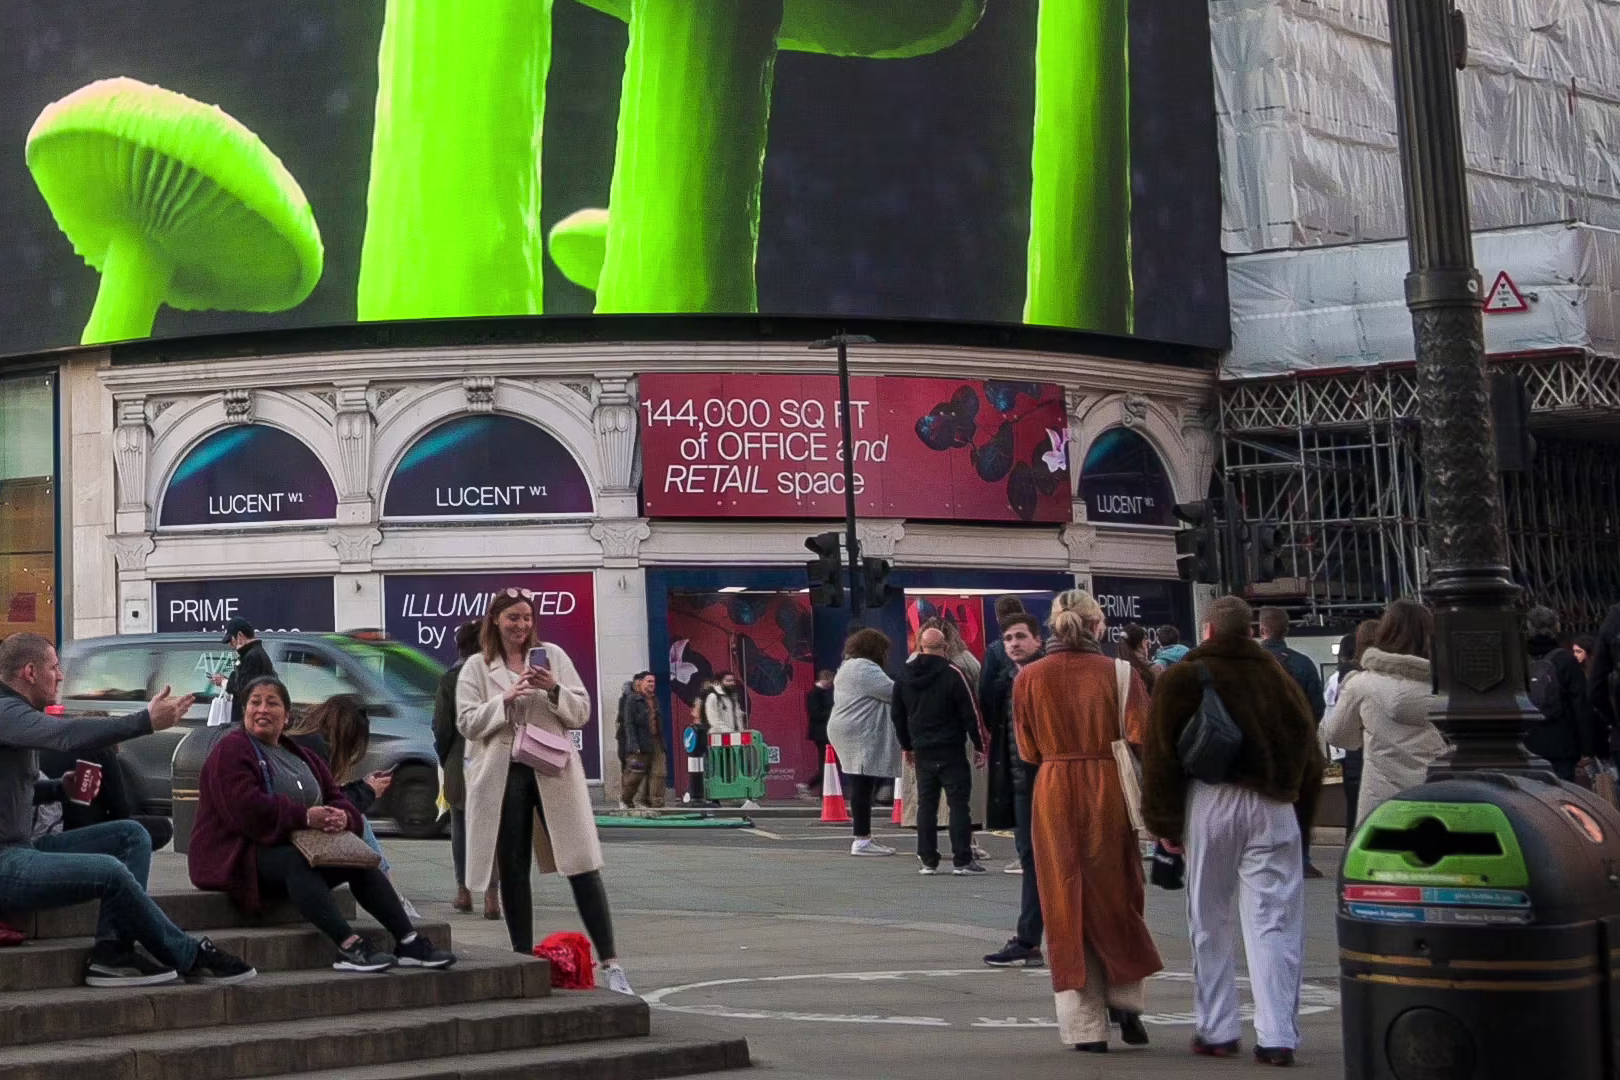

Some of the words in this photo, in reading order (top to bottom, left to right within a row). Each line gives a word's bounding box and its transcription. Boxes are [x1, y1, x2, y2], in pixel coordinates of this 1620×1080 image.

[641, 398, 772, 431] 144,000
[779, 399, 825, 428] SQ
[680, 432, 709, 461] of
[717, 431, 828, 461] OFFICE
[664, 464, 769, 494] RETAIL
[776, 470, 866, 500] space
[208, 493, 285, 515] LUCENT
[287, 492, 304, 503] W1
[435, 485, 526, 507] LUCENT
[529, 485, 548, 497] W1
[1096, 494, 1143, 515] LUCENT
[170, 597, 239, 623] PRIME
[401, 591, 577, 618] ILLUMITED
[1097, 594, 1142, 618] PRIME
[417, 621, 447, 650] by
